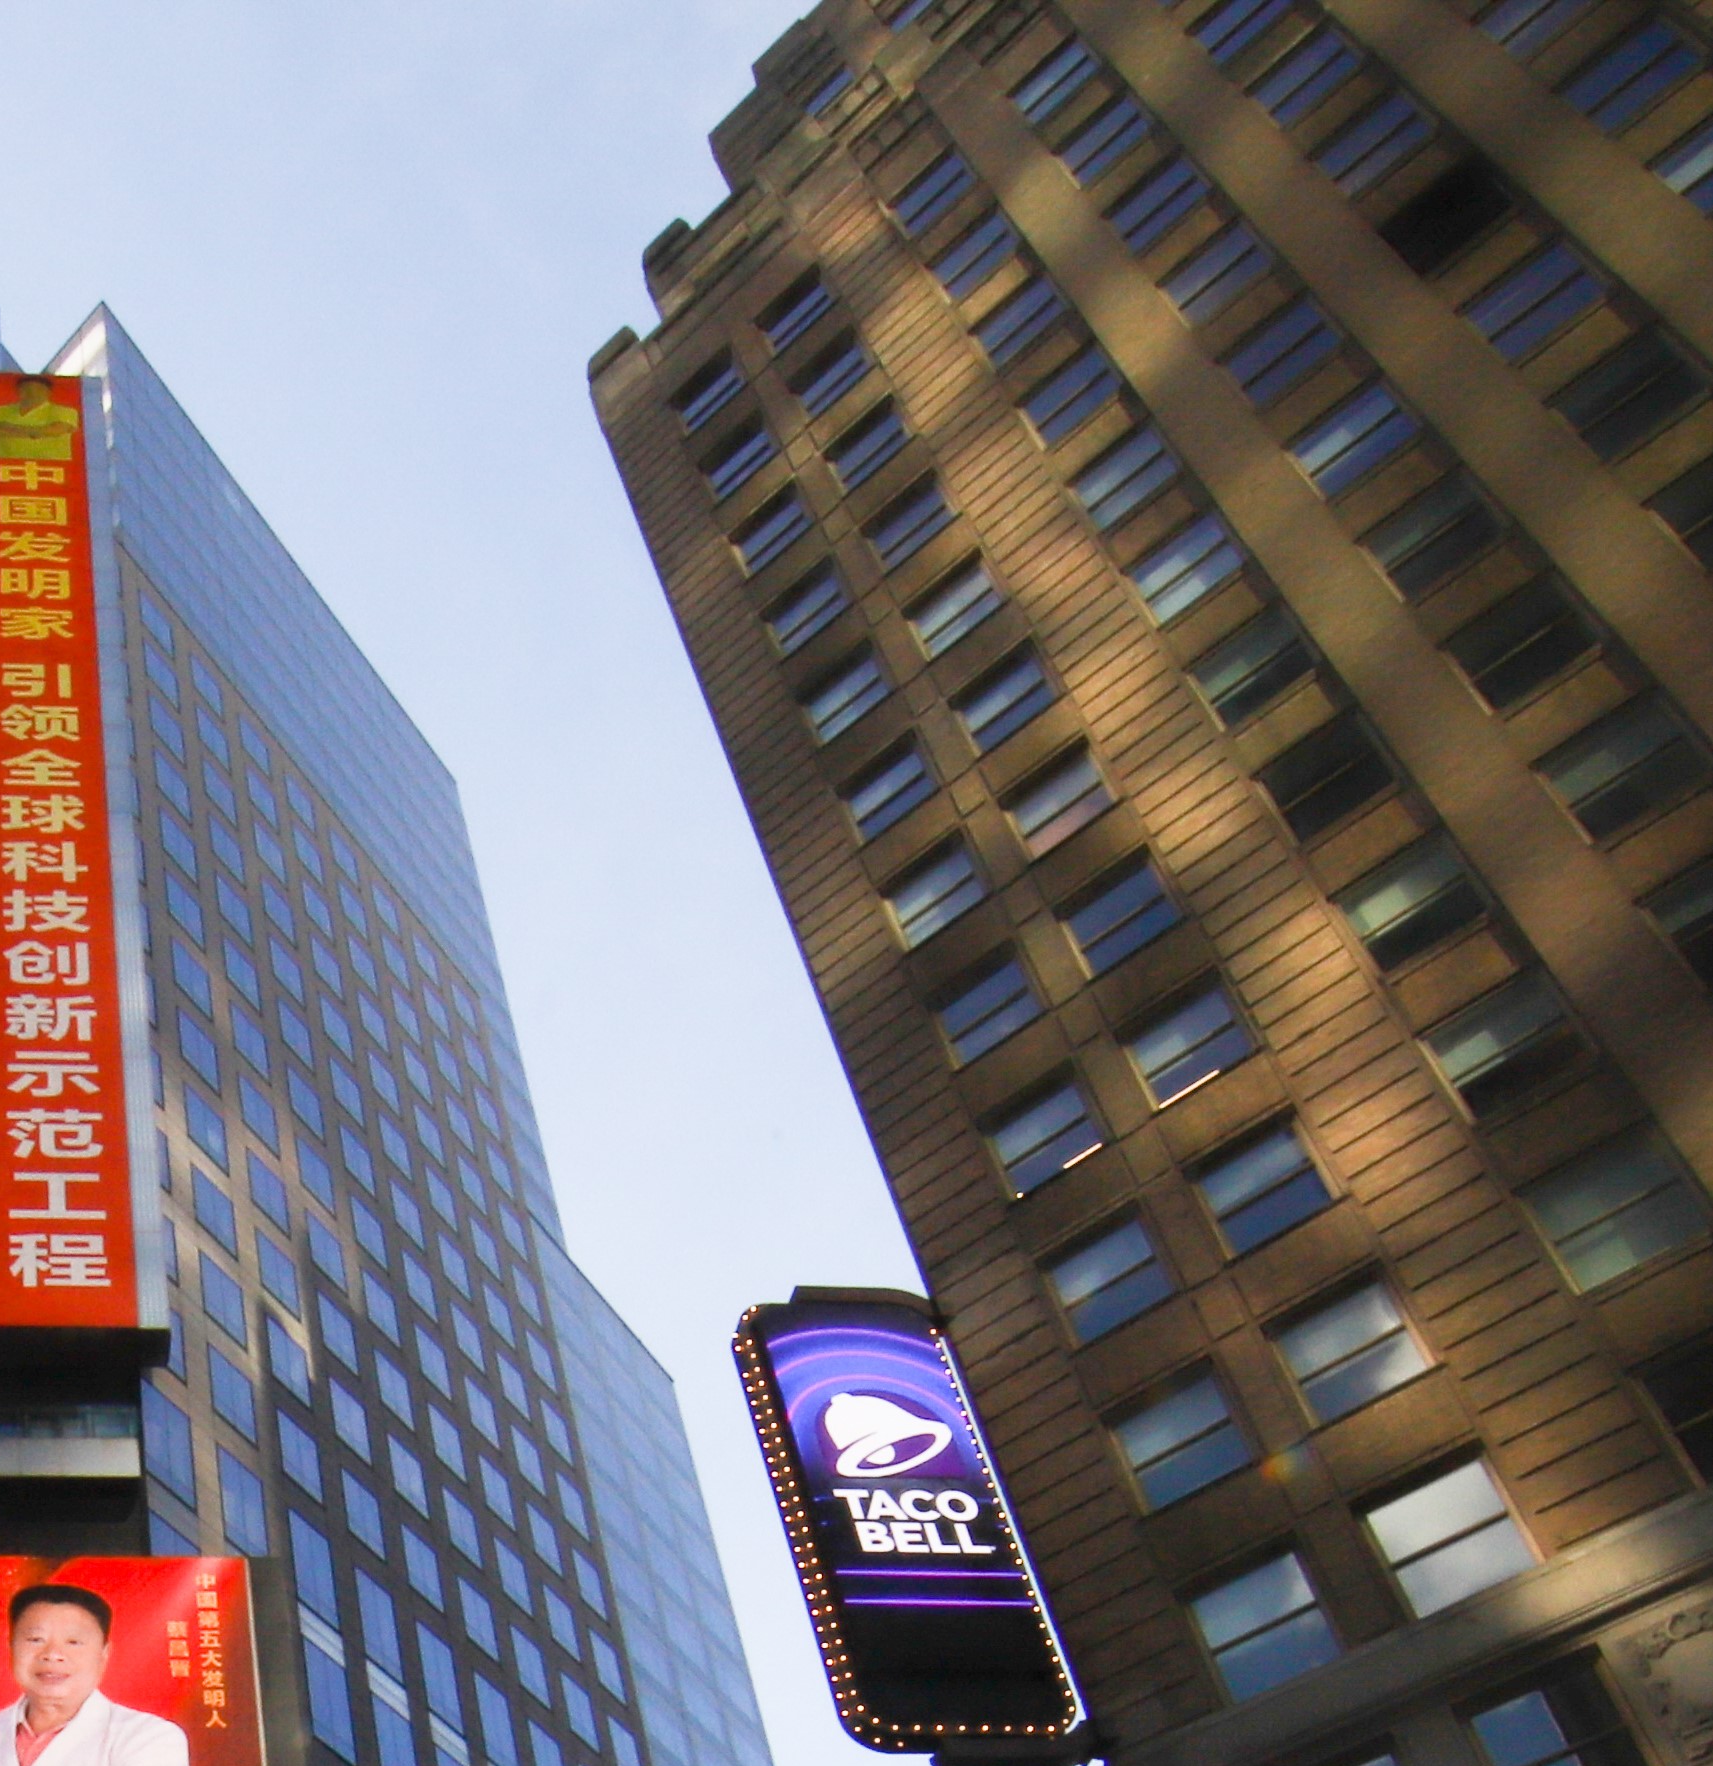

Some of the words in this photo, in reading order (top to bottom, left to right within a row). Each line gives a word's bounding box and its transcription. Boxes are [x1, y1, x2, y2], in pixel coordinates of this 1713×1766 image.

[0, 663, 112, 1288] 引领全球科技创新示范工程
[833, 1487, 980, 1523] TACO
[854, 1521, 996, 1554] BELL
